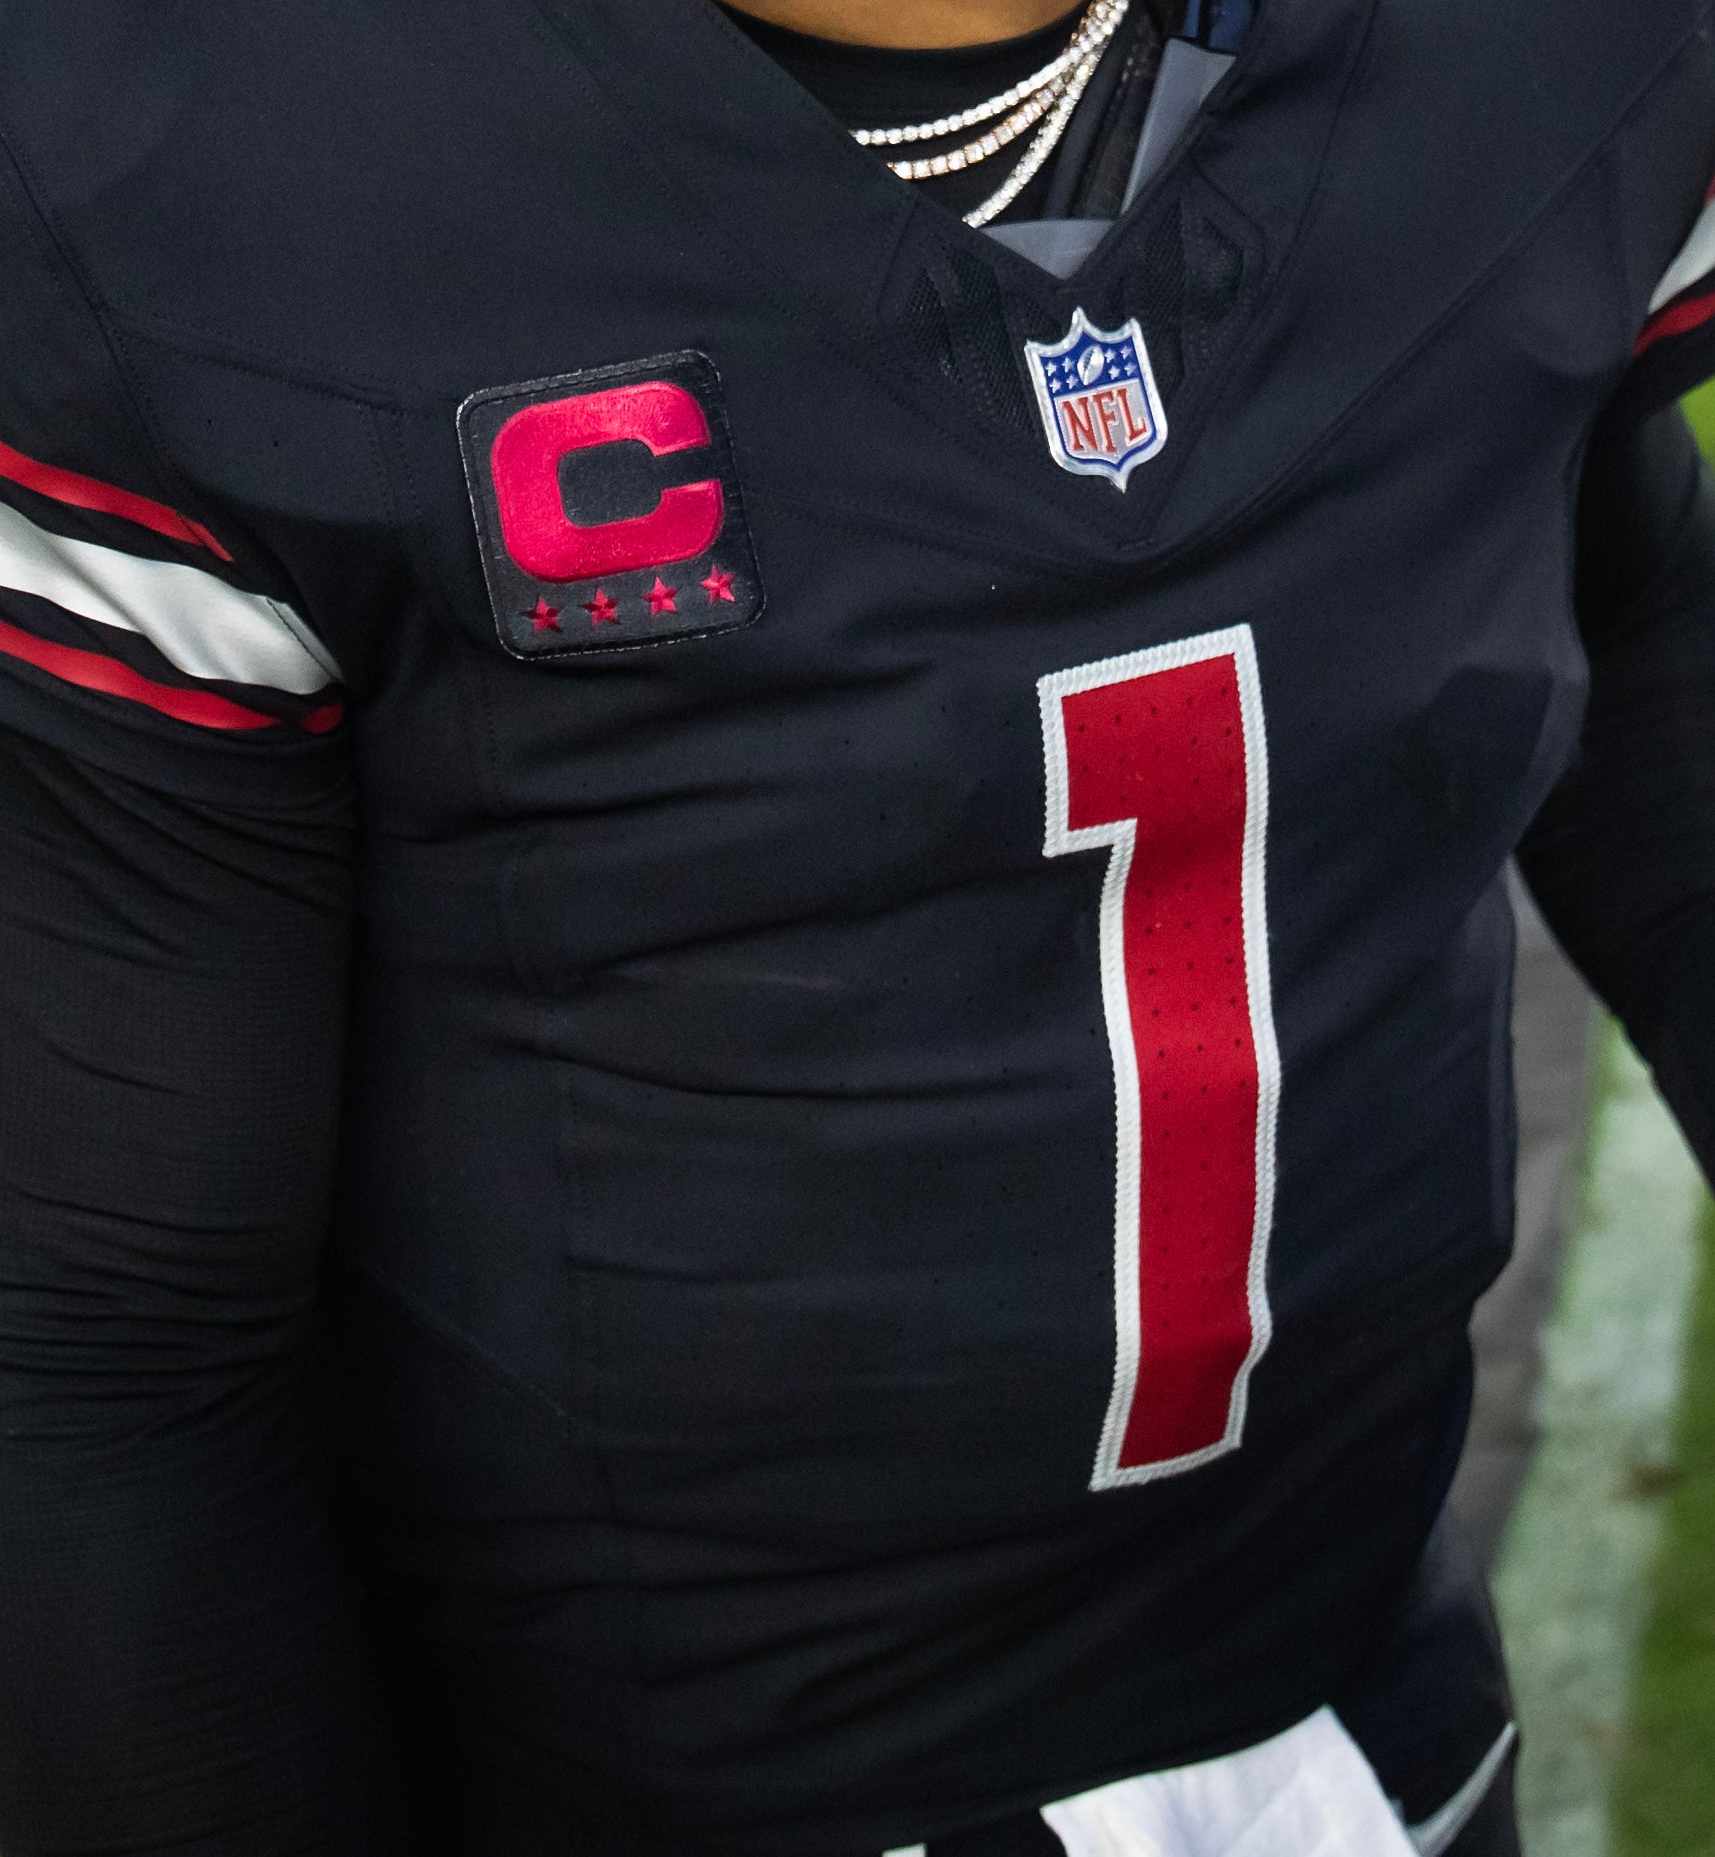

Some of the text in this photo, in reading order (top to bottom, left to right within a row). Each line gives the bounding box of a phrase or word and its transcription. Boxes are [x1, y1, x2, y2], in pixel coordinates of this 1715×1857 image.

[490, 381, 724, 584] C
[1061, 387, 1148, 454] NFL
[1038, 623, 1281, 1492] 1
